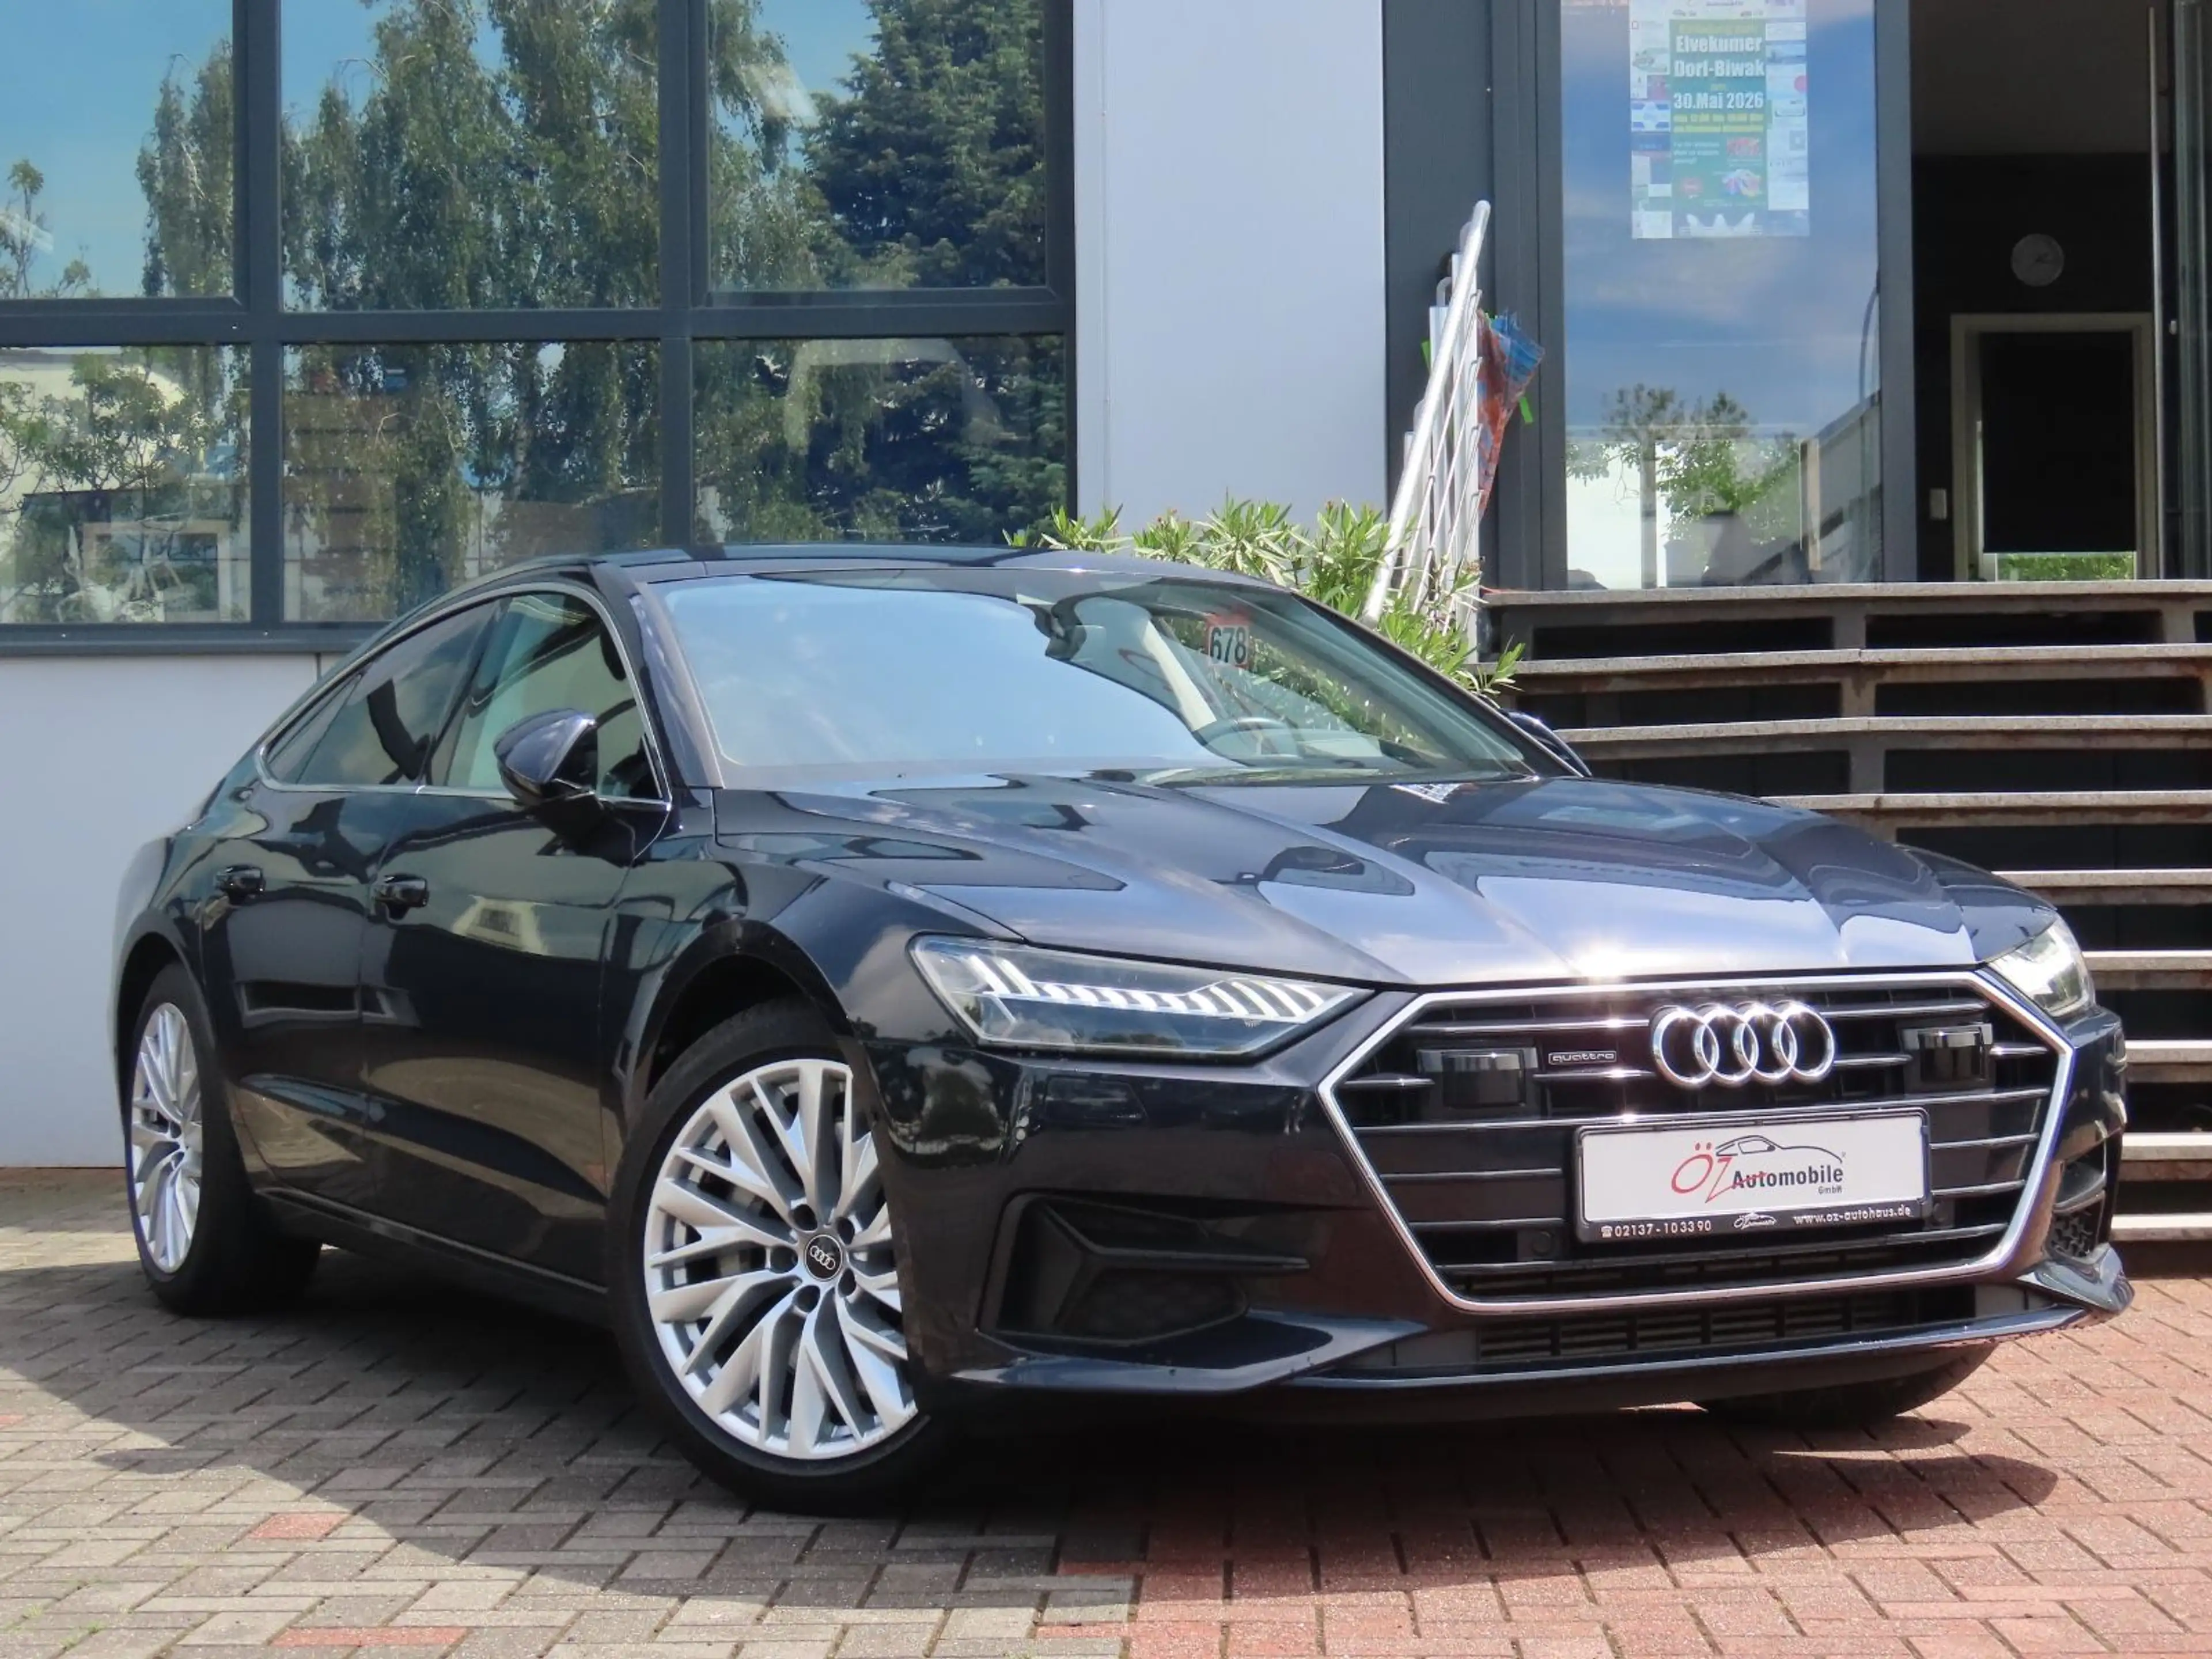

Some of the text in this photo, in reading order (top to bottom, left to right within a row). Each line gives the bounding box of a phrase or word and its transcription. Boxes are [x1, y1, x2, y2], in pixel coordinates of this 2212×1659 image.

[1726, 91, 1764, 109] 2026
[1210, 627, 1247, 664] 678
[1552, 1052, 1614, 1063] quattro
[1732, 1164, 1844, 1190] Automobile
[1818, 1185, 1843, 1195] GmbH
[1793, 1204, 1911, 1225] www.oz-autohaus.de
